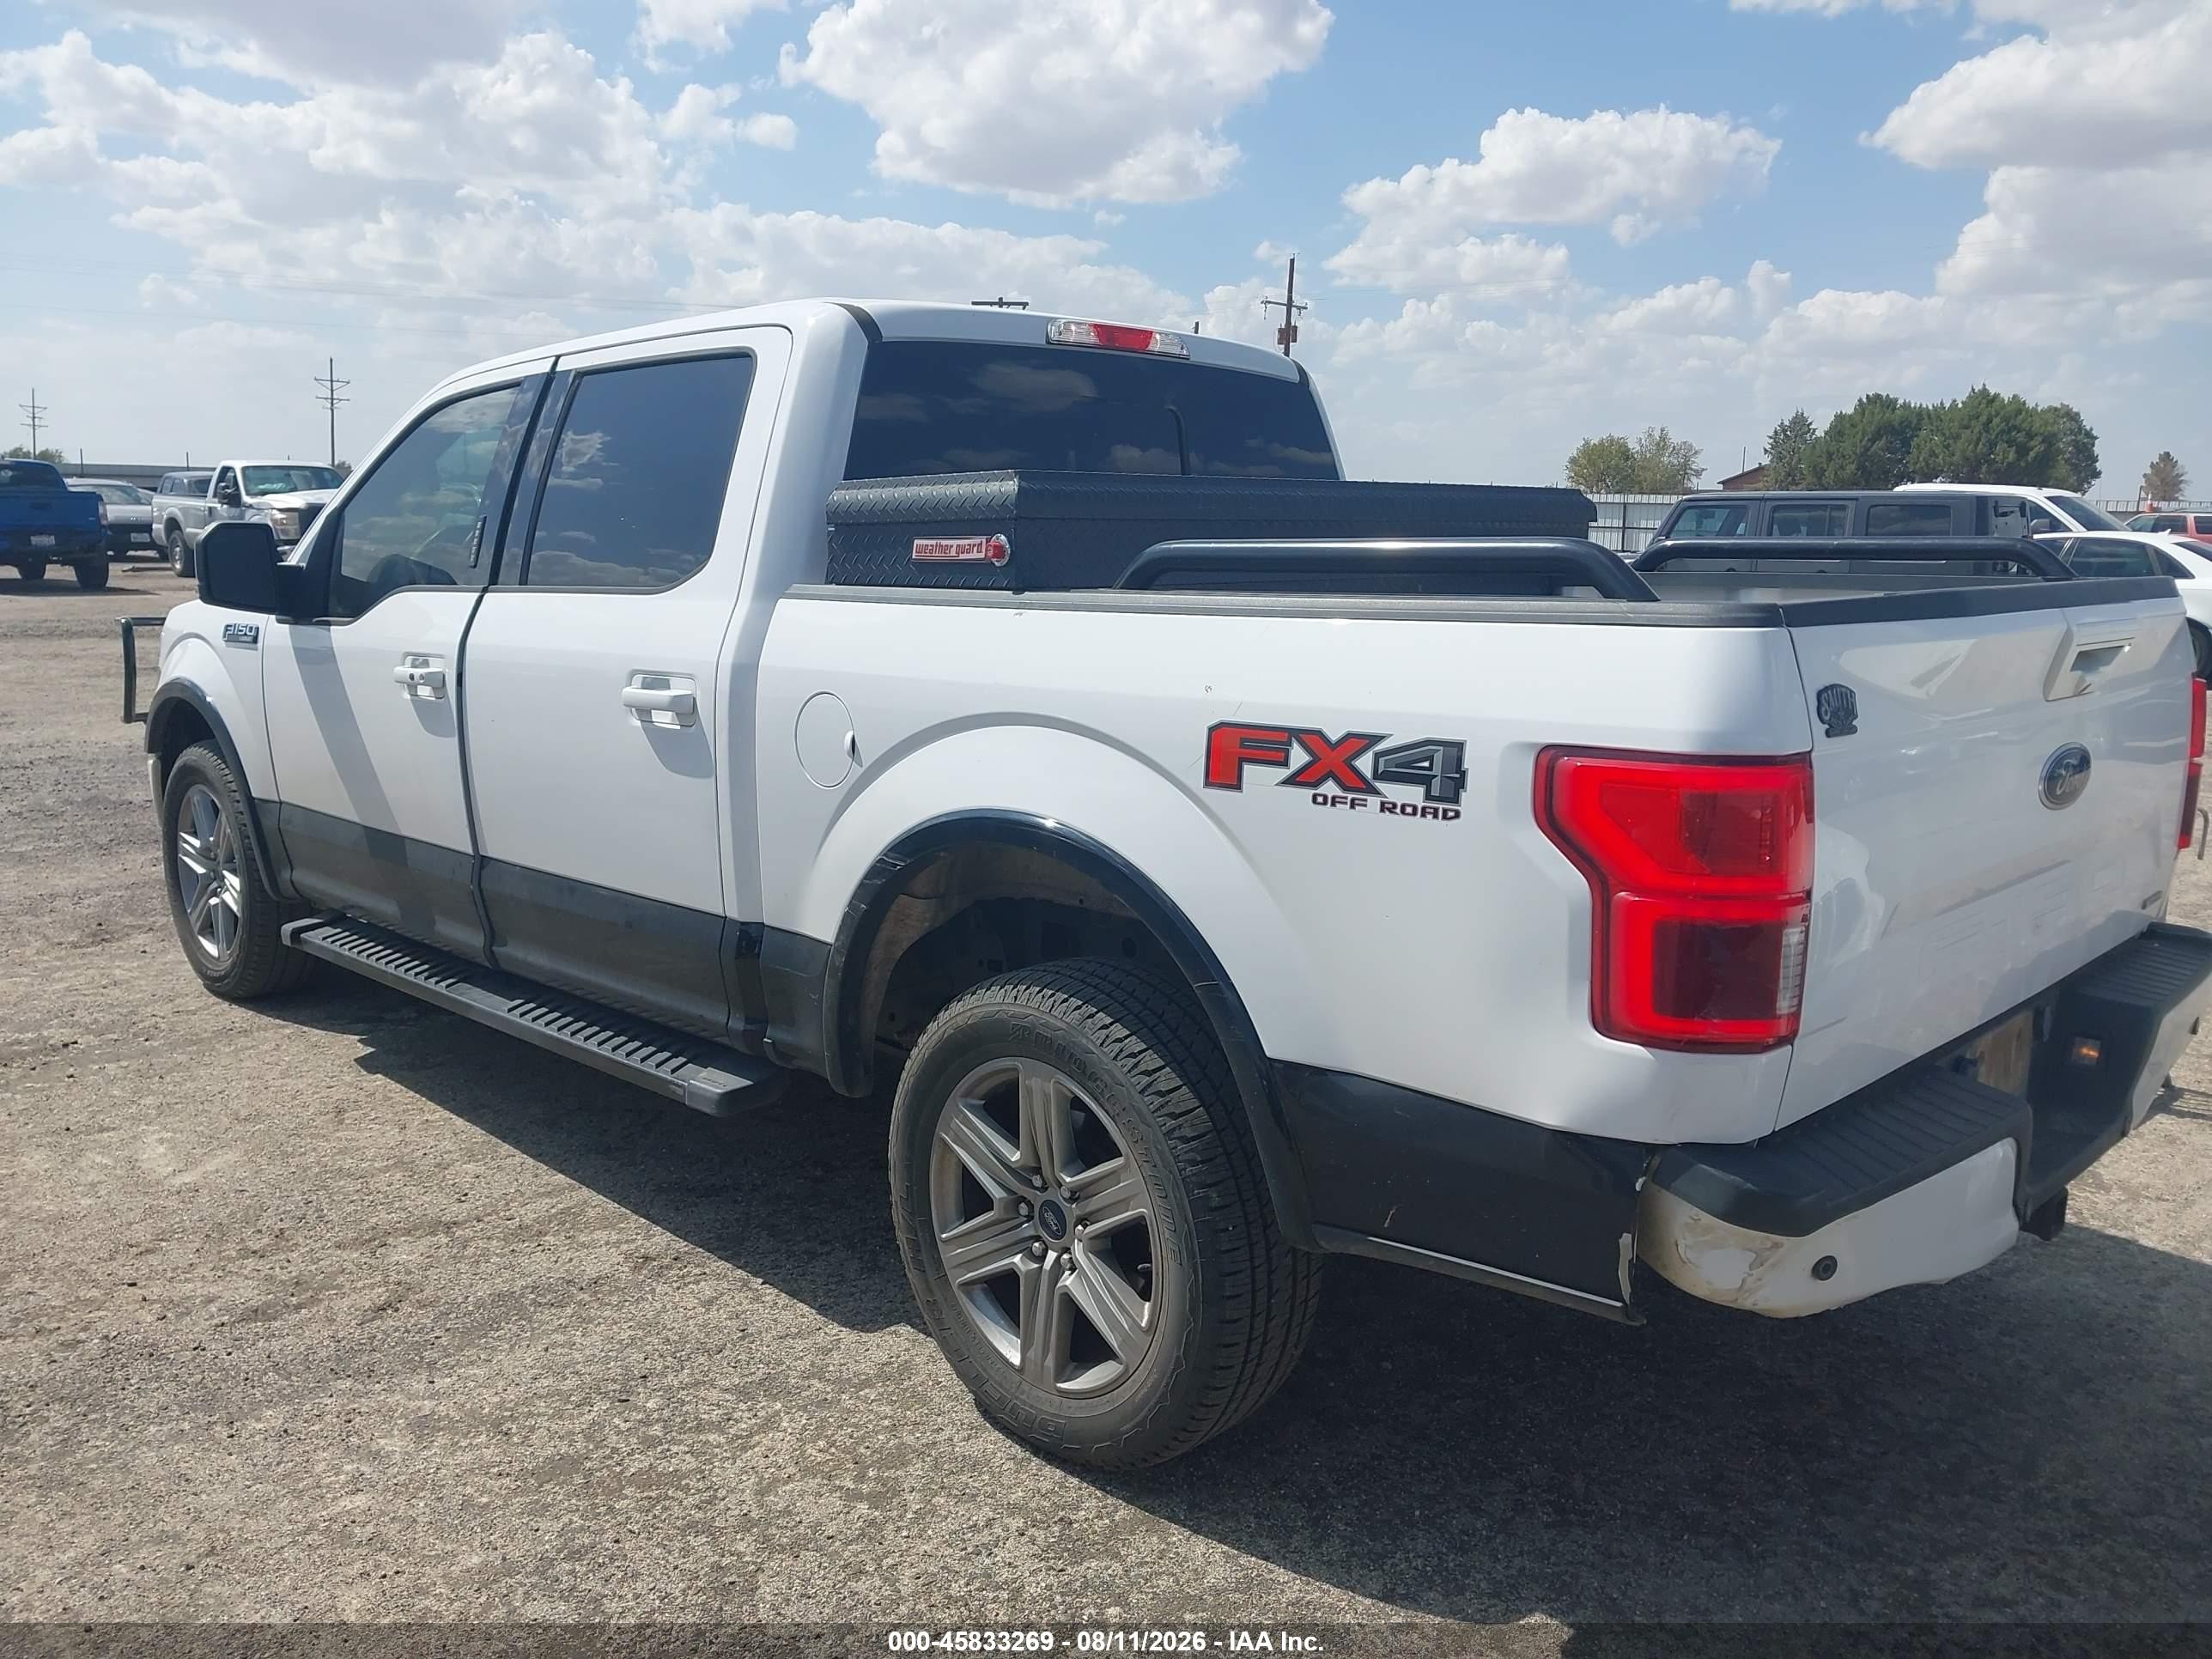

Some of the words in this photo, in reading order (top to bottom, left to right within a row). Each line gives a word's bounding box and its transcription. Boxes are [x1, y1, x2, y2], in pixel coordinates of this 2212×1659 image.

[915, 541, 954, 555] weather
[955, 540, 984, 556] guard
[1203, 720, 1468, 807] FX4
[1311, 792, 1368, 810] OFF
[1378, 799, 1462, 821] ROAD
